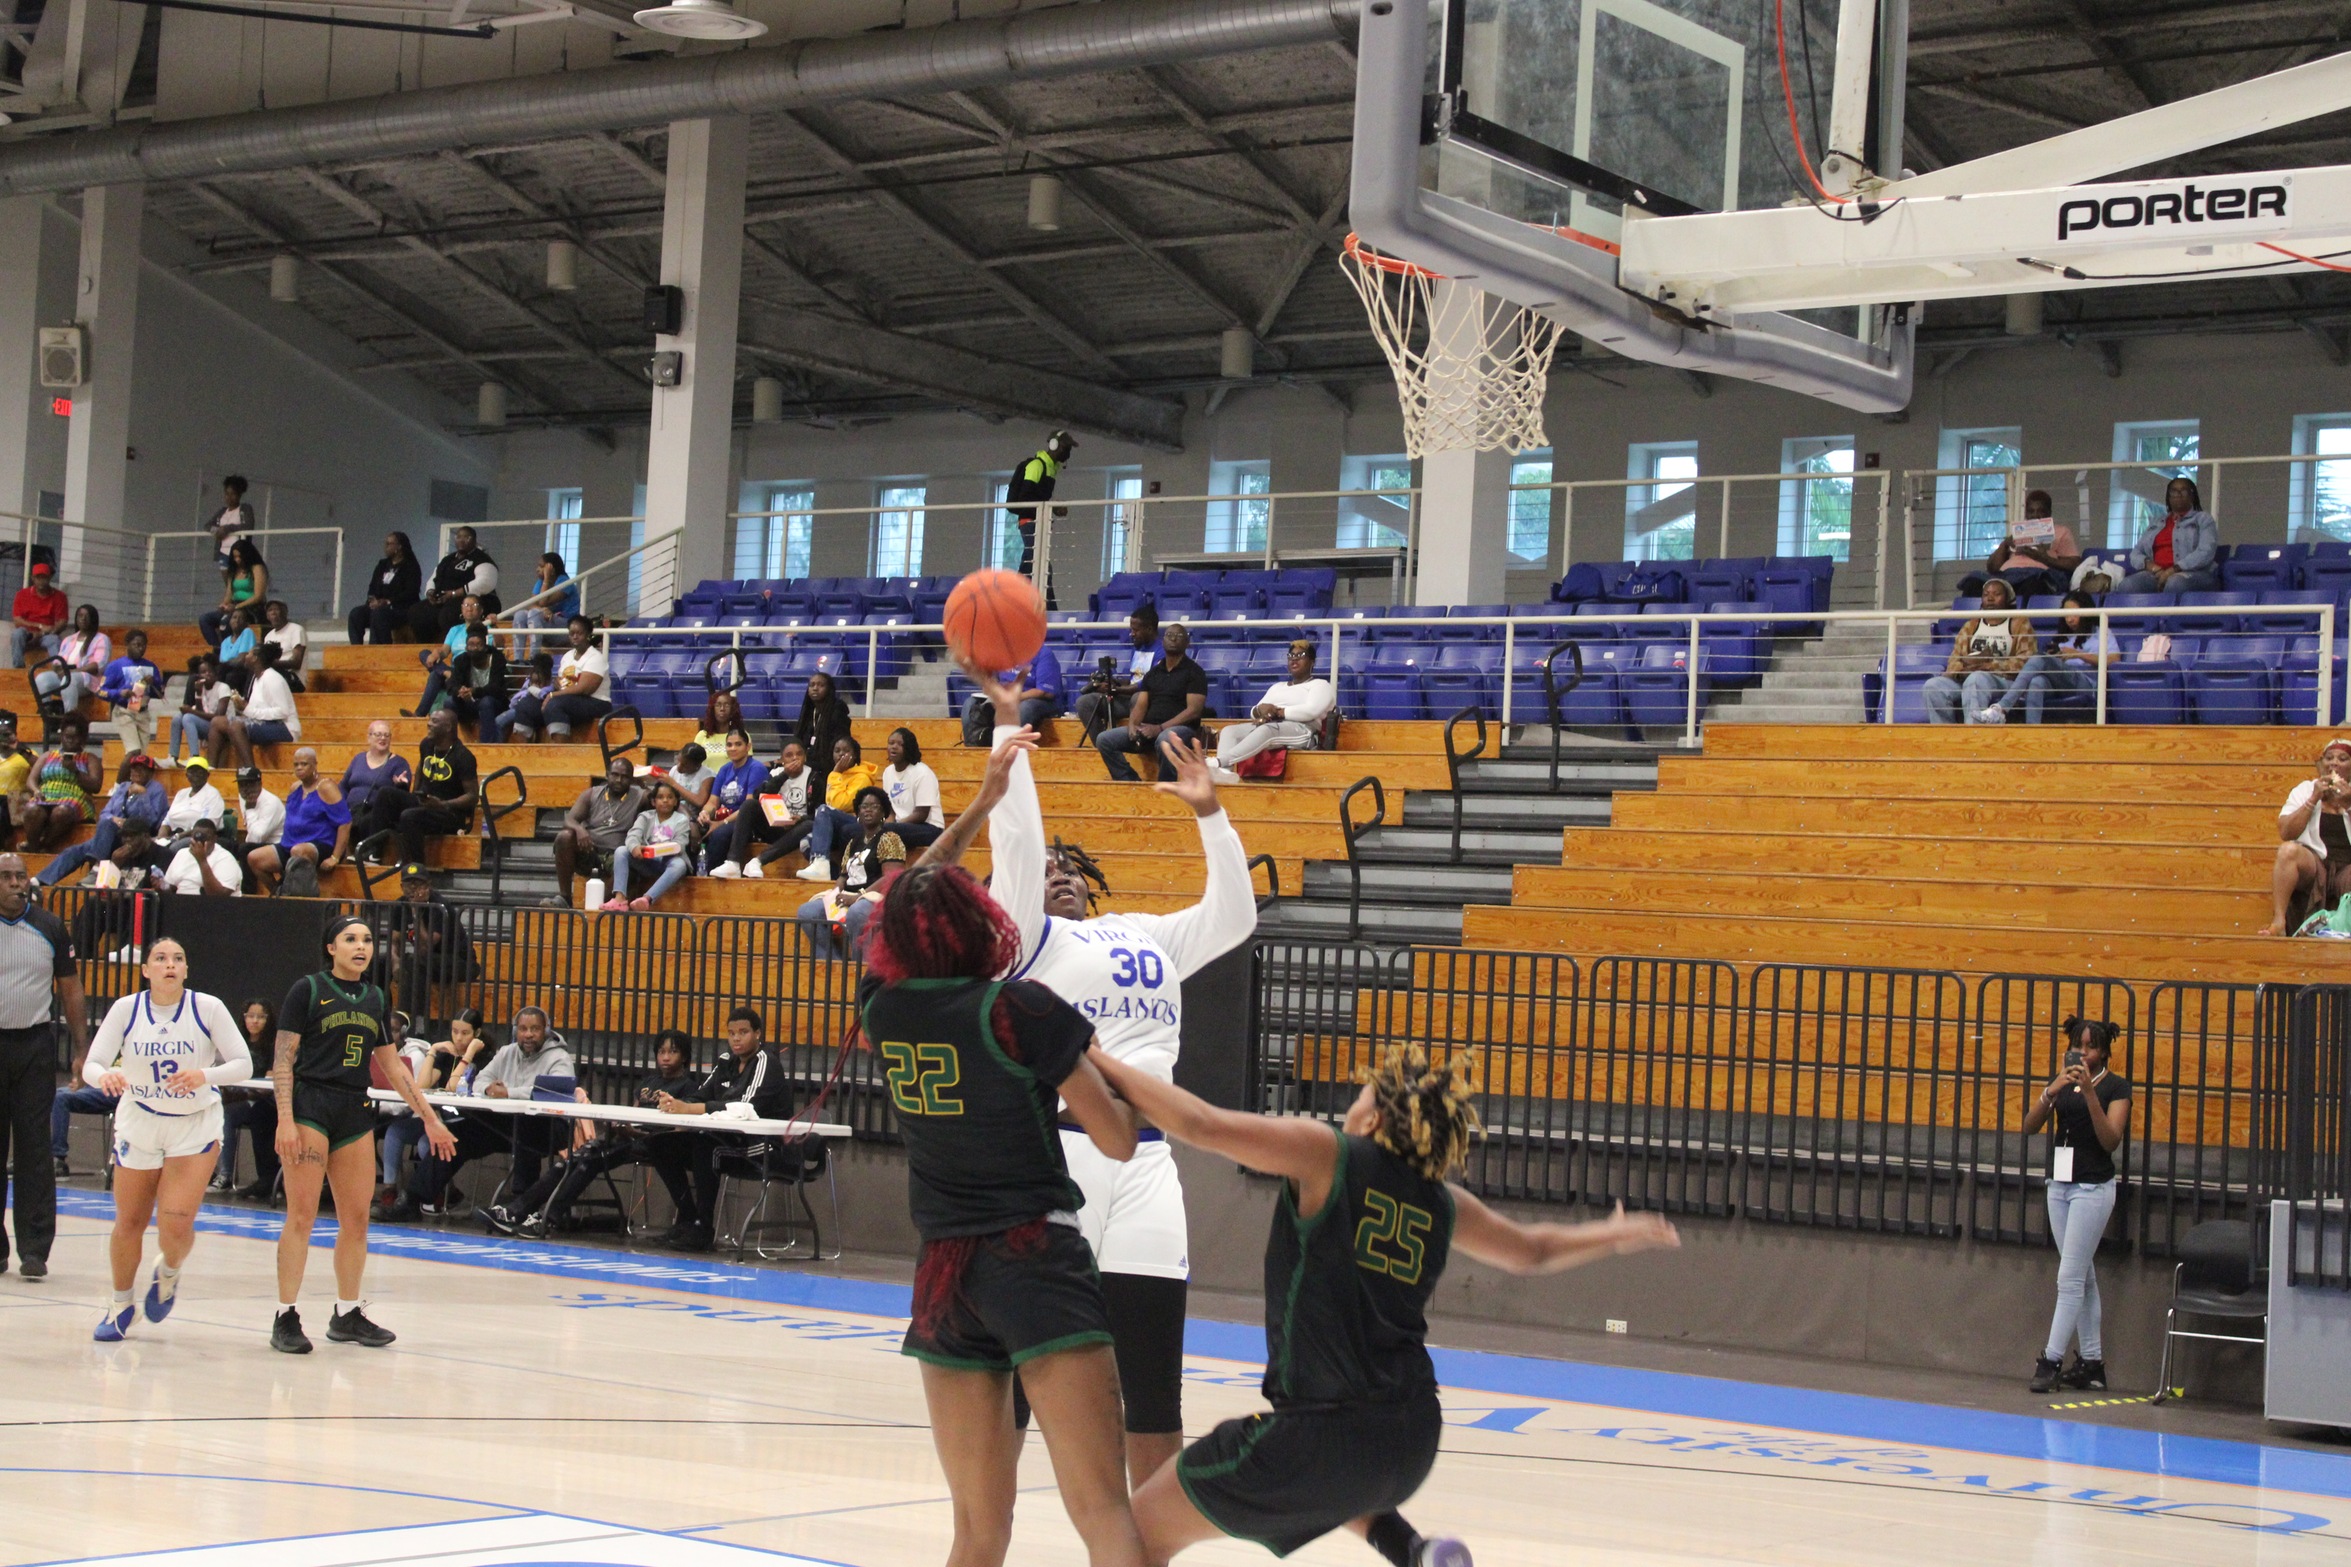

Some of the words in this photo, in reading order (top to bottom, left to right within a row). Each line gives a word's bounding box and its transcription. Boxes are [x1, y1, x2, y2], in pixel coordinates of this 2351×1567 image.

[1109, 947, 1164, 990] 30
[133, 1041, 195, 1057] VIRGIN
[343, 1034, 364, 1067] 5
[149, 1060, 179, 1084] 13
[881, 1041, 964, 1115] 22
[1354, 1187, 1432, 1286] 25
[1547, 1427, 2331, 1538] University
